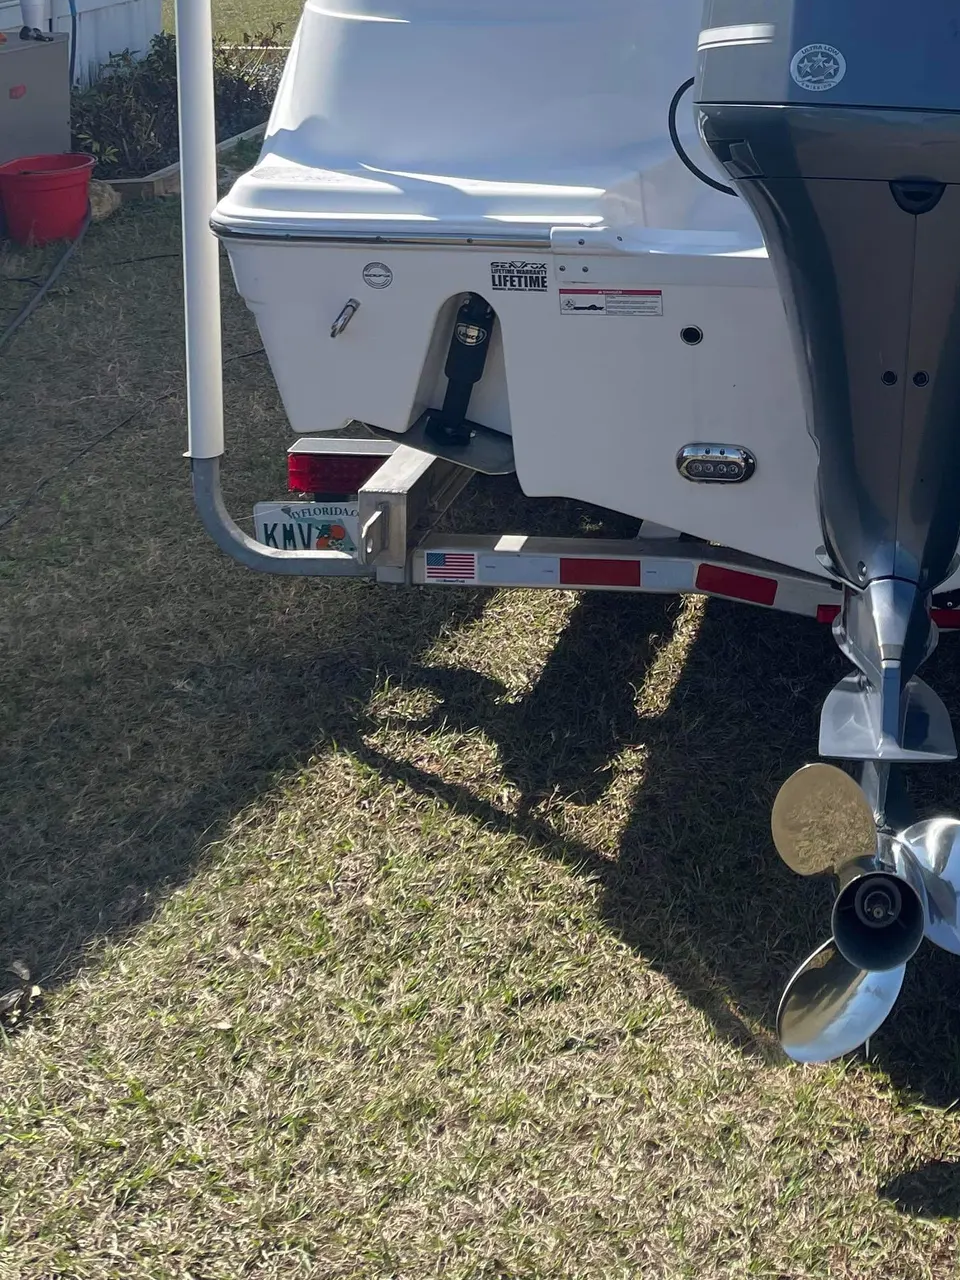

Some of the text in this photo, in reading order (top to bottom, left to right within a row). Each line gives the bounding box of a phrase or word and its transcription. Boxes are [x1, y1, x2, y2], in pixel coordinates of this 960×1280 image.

[801, 44, 840, 56] ULTRA LOW
[491, 274, 548, 288] LIFETIME
[263, 523, 313, 550] KMV
